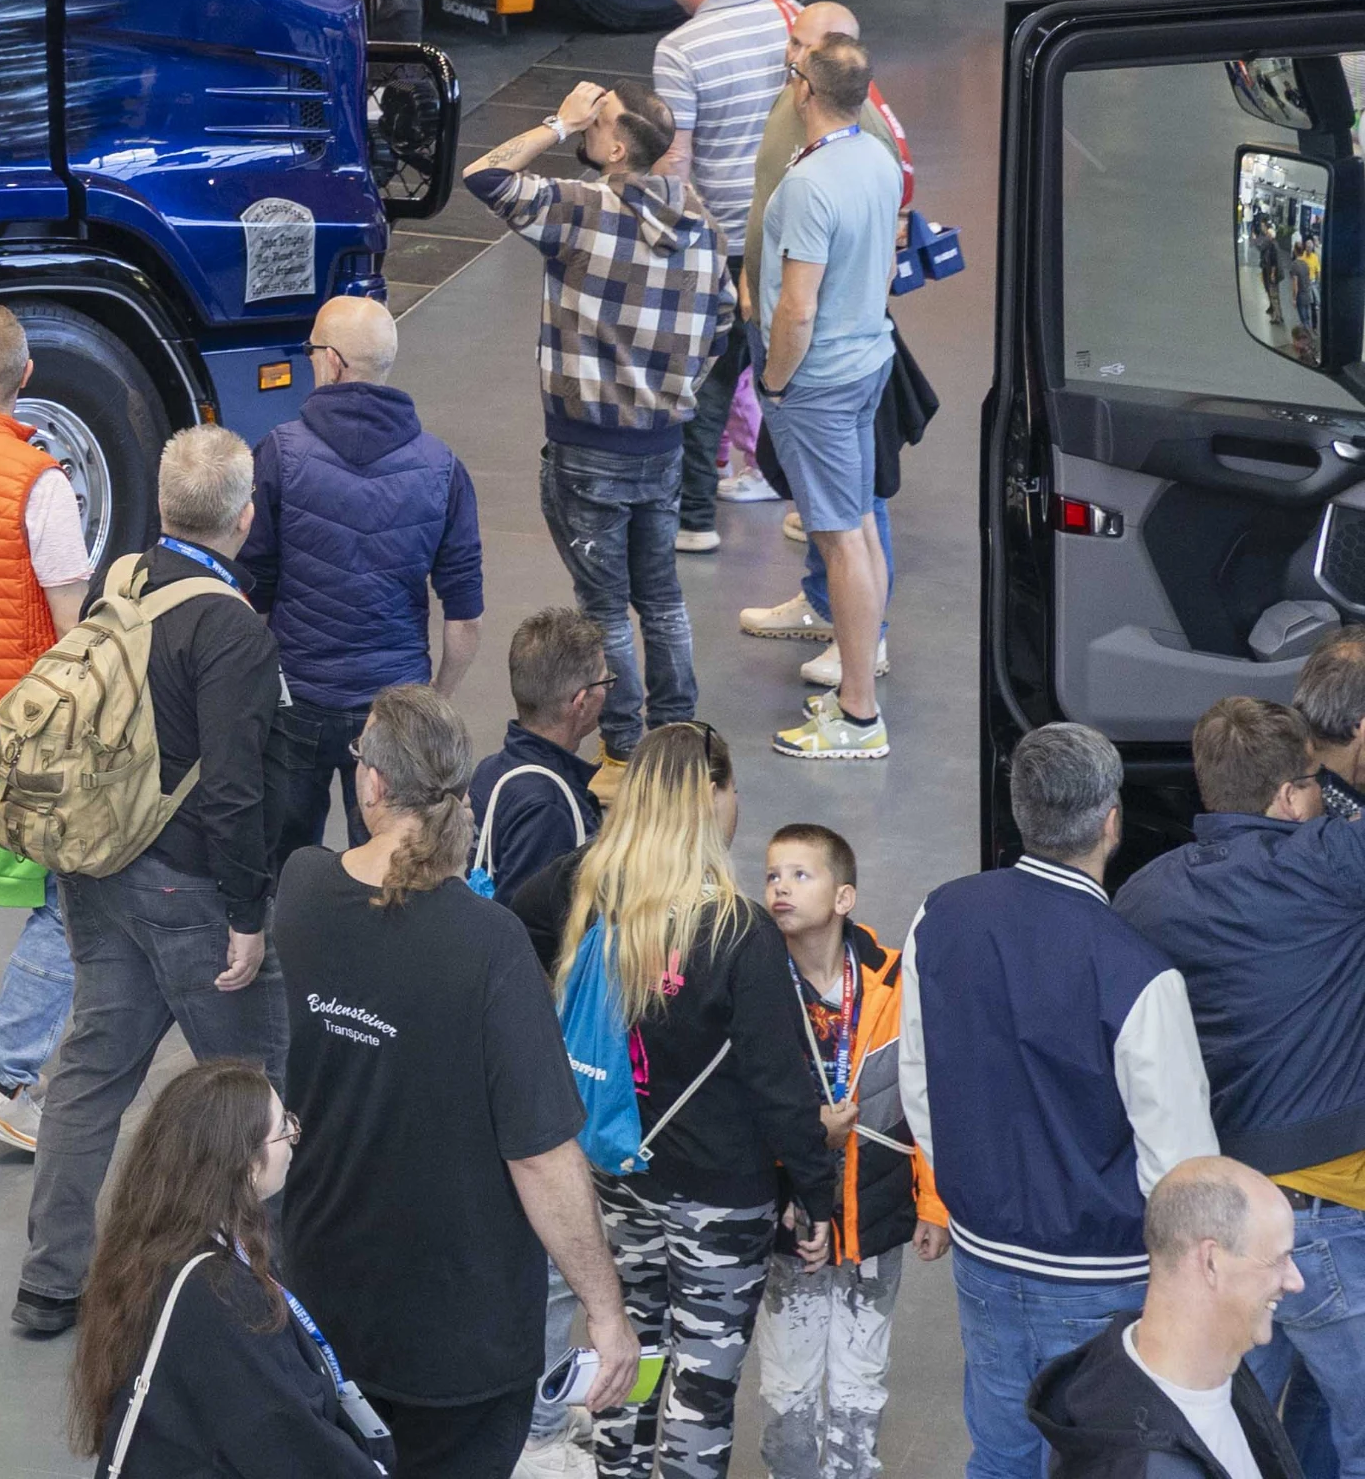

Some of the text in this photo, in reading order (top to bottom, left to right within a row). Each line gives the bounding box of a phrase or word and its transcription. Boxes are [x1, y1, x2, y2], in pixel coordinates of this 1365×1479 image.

[307, 993, 398, 1038] Bodensteiner
[323, 1018, 381, 1047] Transporte
[842, 1001, 851, 1040] MOVING!
[836, 1048, 848, 1084] NUFAM
[288, 1297, 317, 1335] NUFAM
